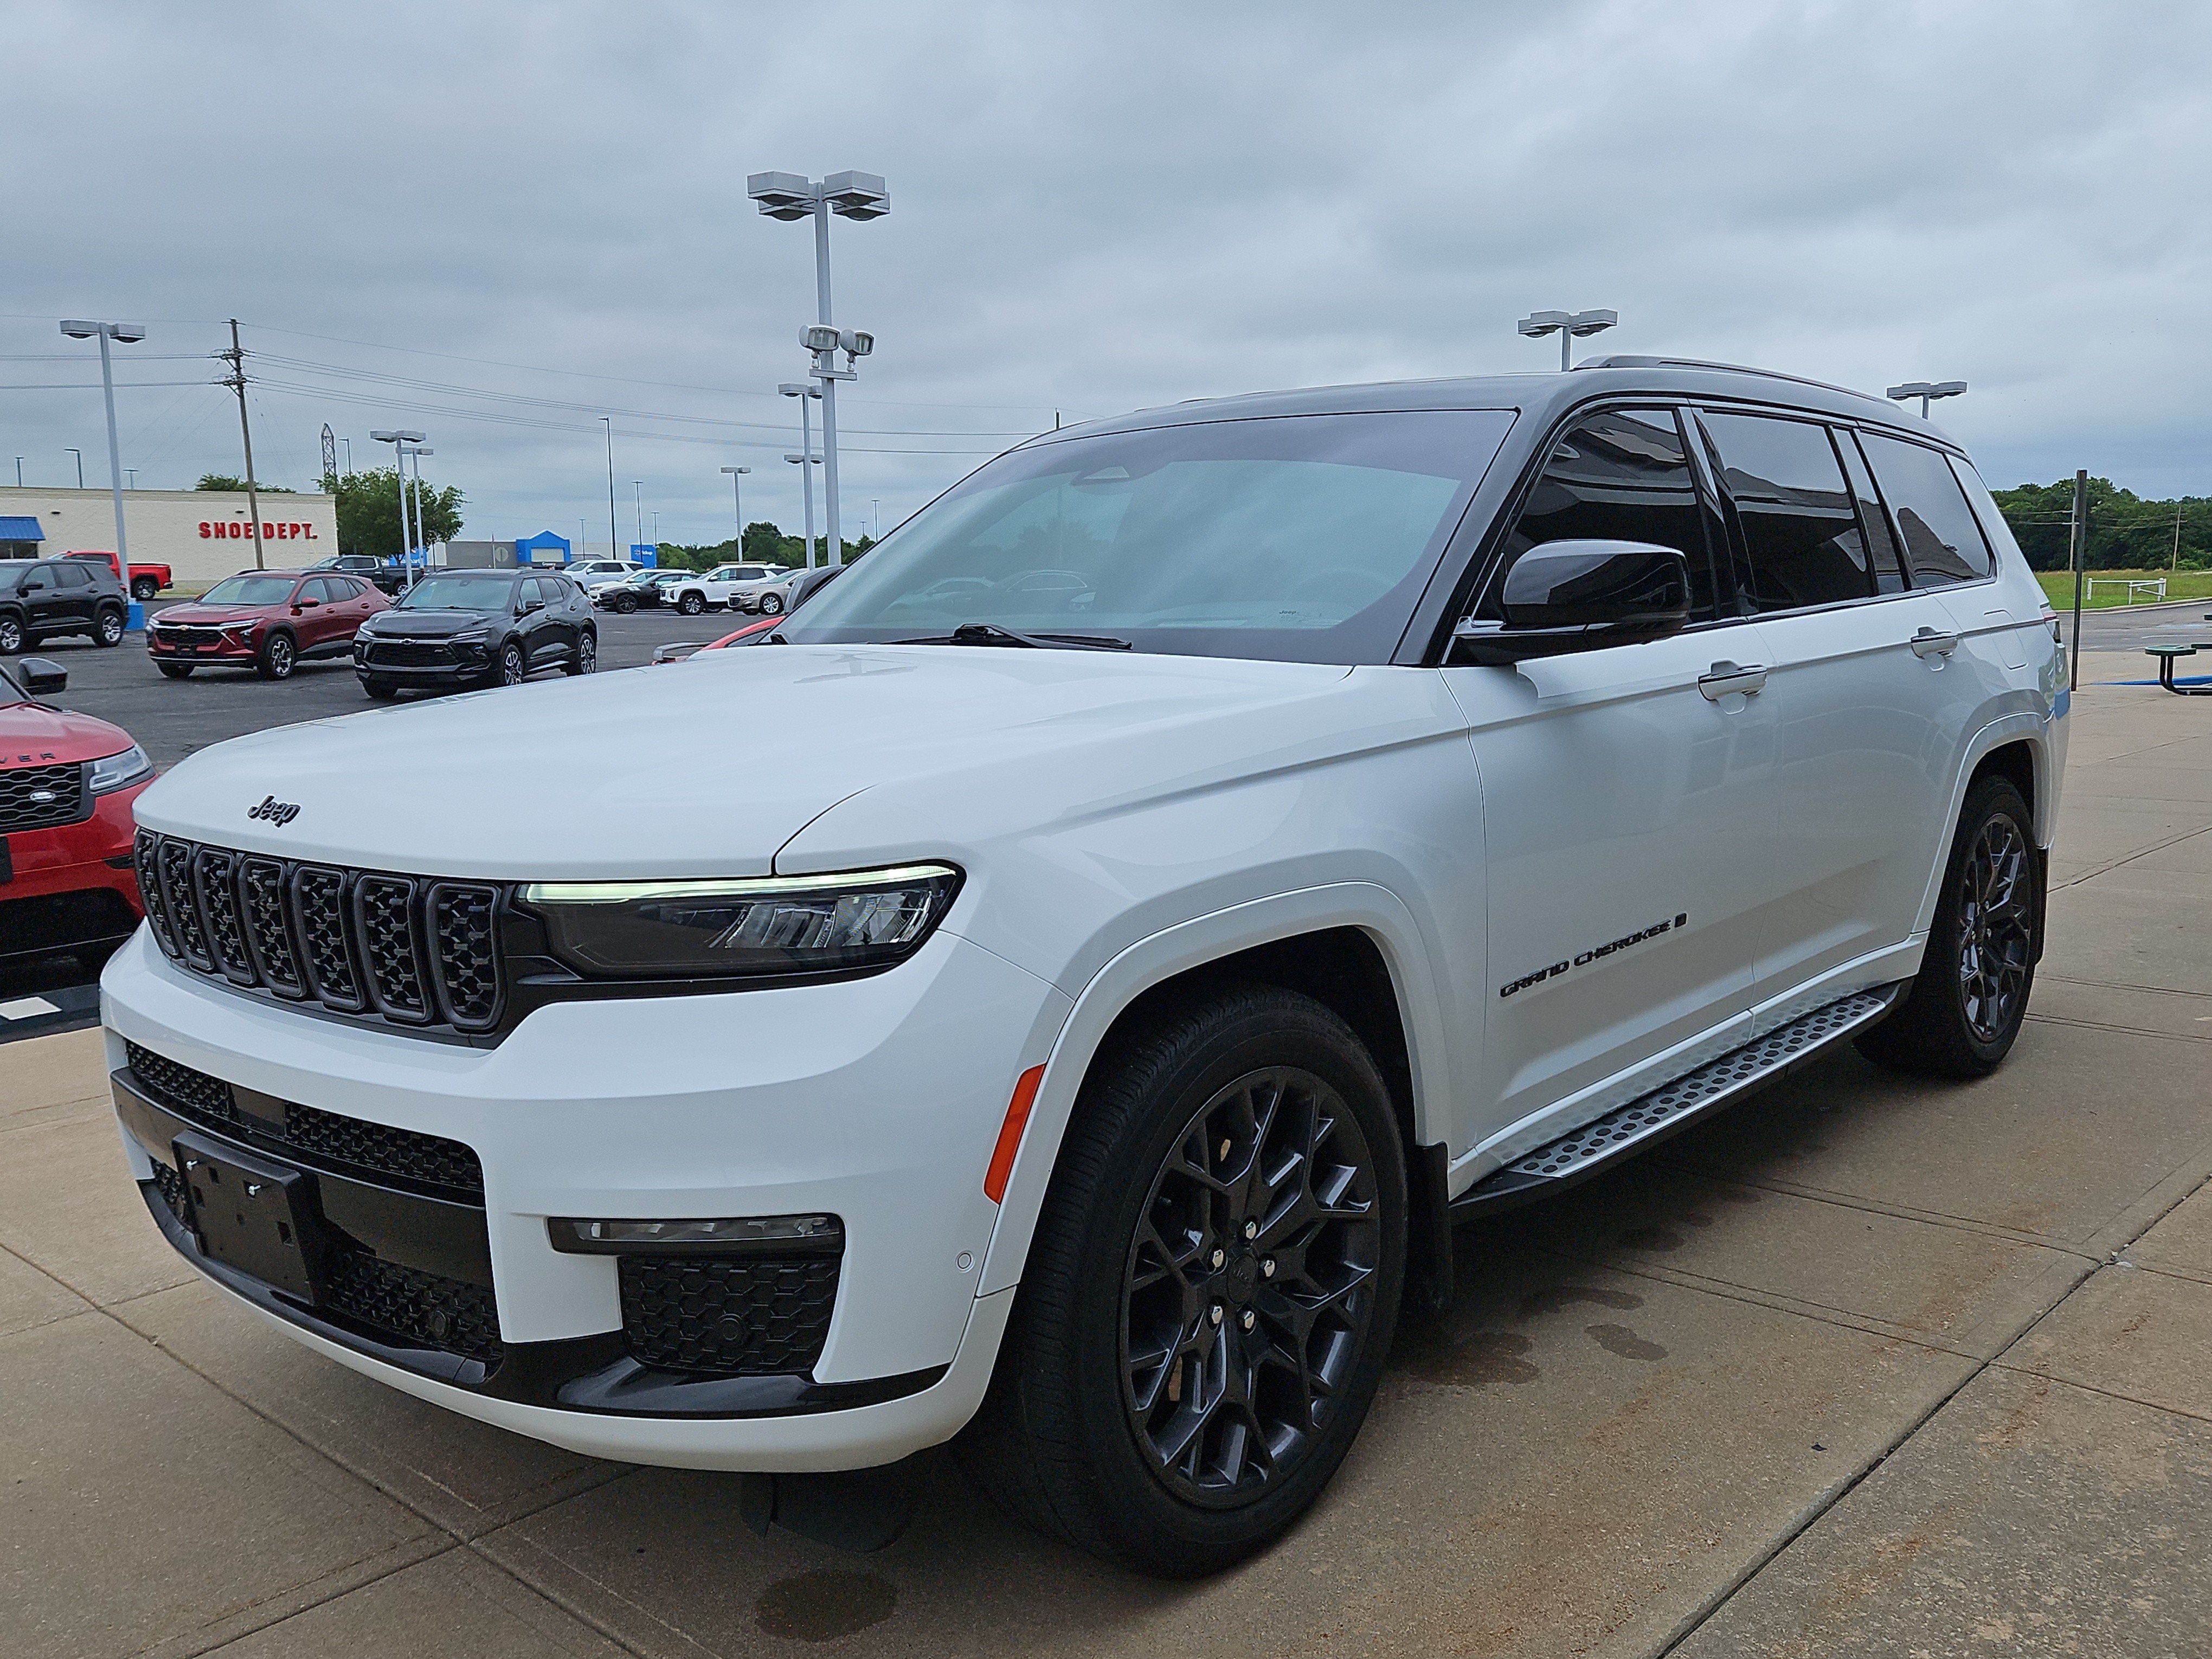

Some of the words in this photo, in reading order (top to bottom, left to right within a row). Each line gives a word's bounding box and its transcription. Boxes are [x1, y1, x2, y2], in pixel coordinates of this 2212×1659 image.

[198, 522, 254, 539] SHOE
[262, 523, 318, 539] DEPT.
[247, 795, 301, 828] Jeep
[1500, 960, 1569, 997] GRAND
[1574, 918, 1671, 966] CHEROKEE
